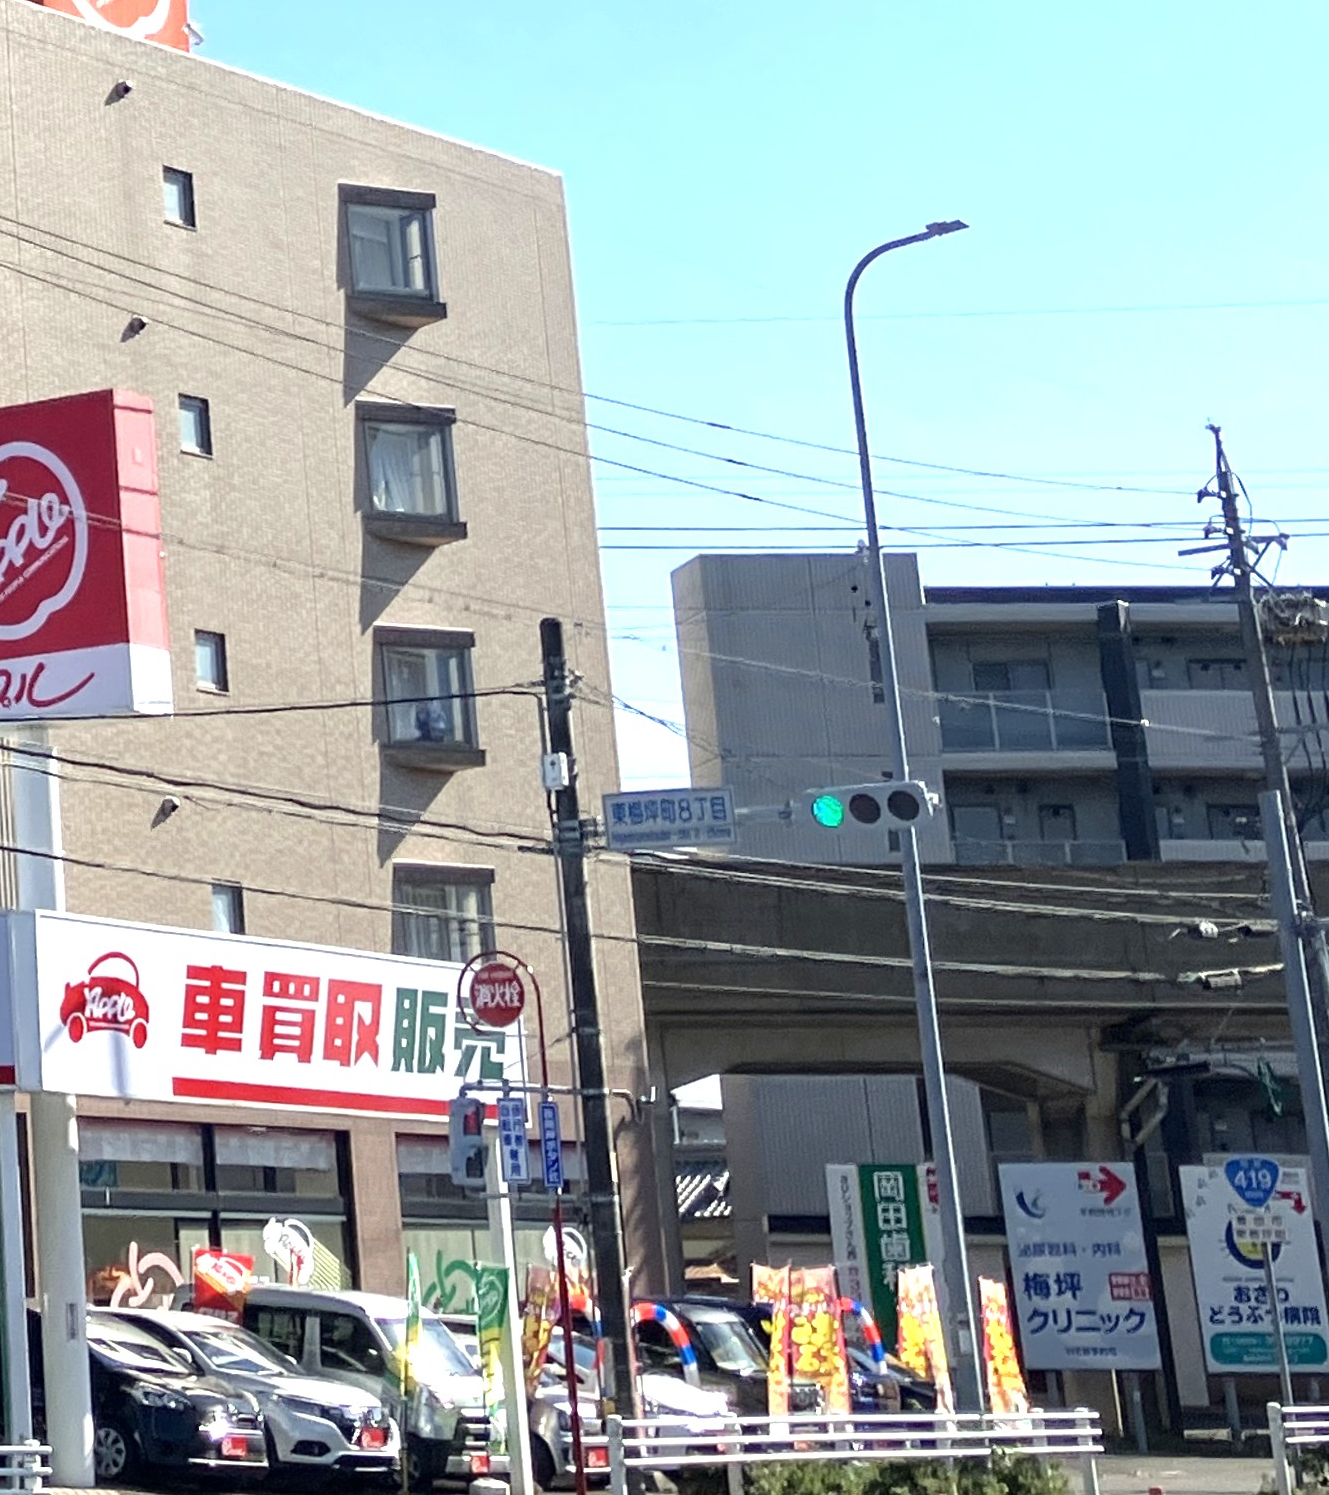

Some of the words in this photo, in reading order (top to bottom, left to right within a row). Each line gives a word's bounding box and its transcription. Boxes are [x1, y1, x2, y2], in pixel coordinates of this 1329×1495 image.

[474, 980, 522, 1008] 消火栓
[1234, 1169, 1272, 1191] 419
[1023, 1271, 1084, 1301] 梅坪
[1027, 1306, 1146, 1335] クリニック
